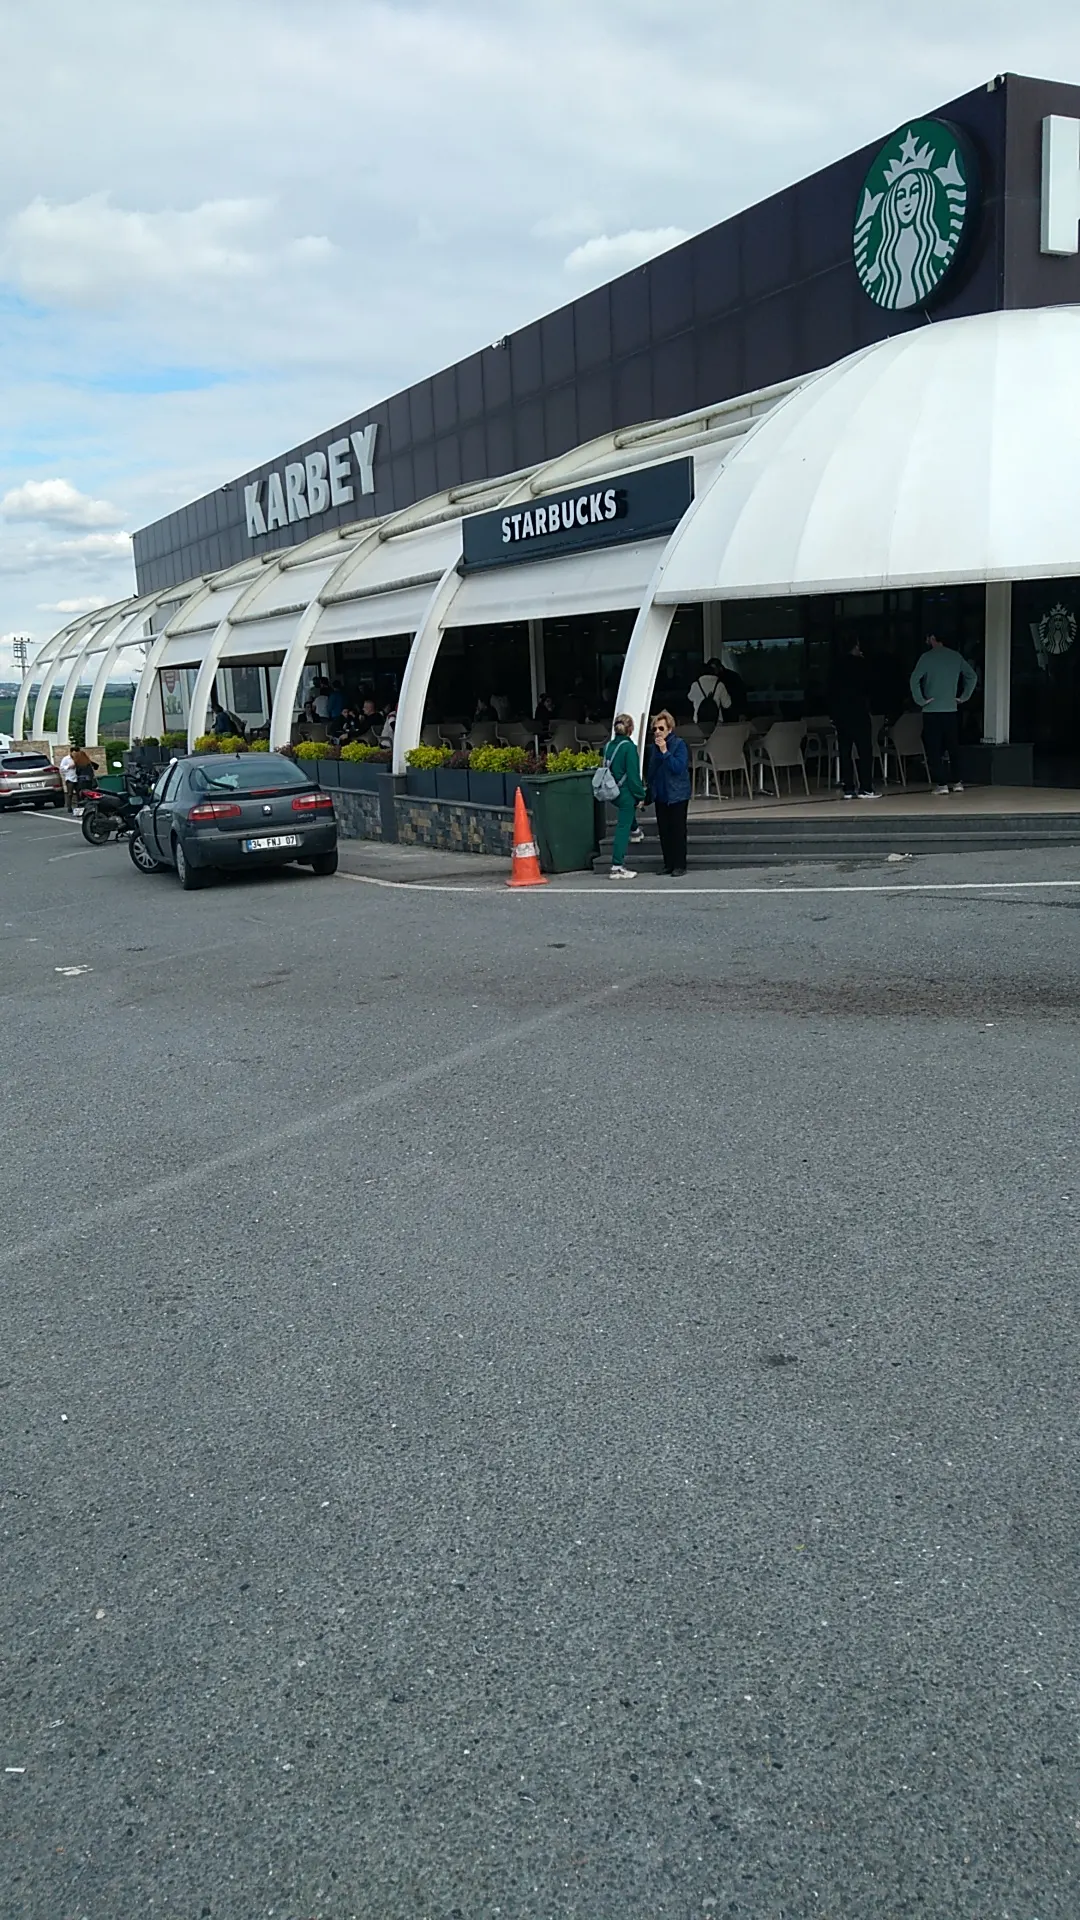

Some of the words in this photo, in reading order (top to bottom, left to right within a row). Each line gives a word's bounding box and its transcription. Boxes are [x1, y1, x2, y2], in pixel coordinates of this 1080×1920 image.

[244, 423, 378, 538] KARBEY
[501, 489, 617, 543] STARBUCKS
[251, 840, 262, 849] 34
[285, 836, 295, 845] 07
